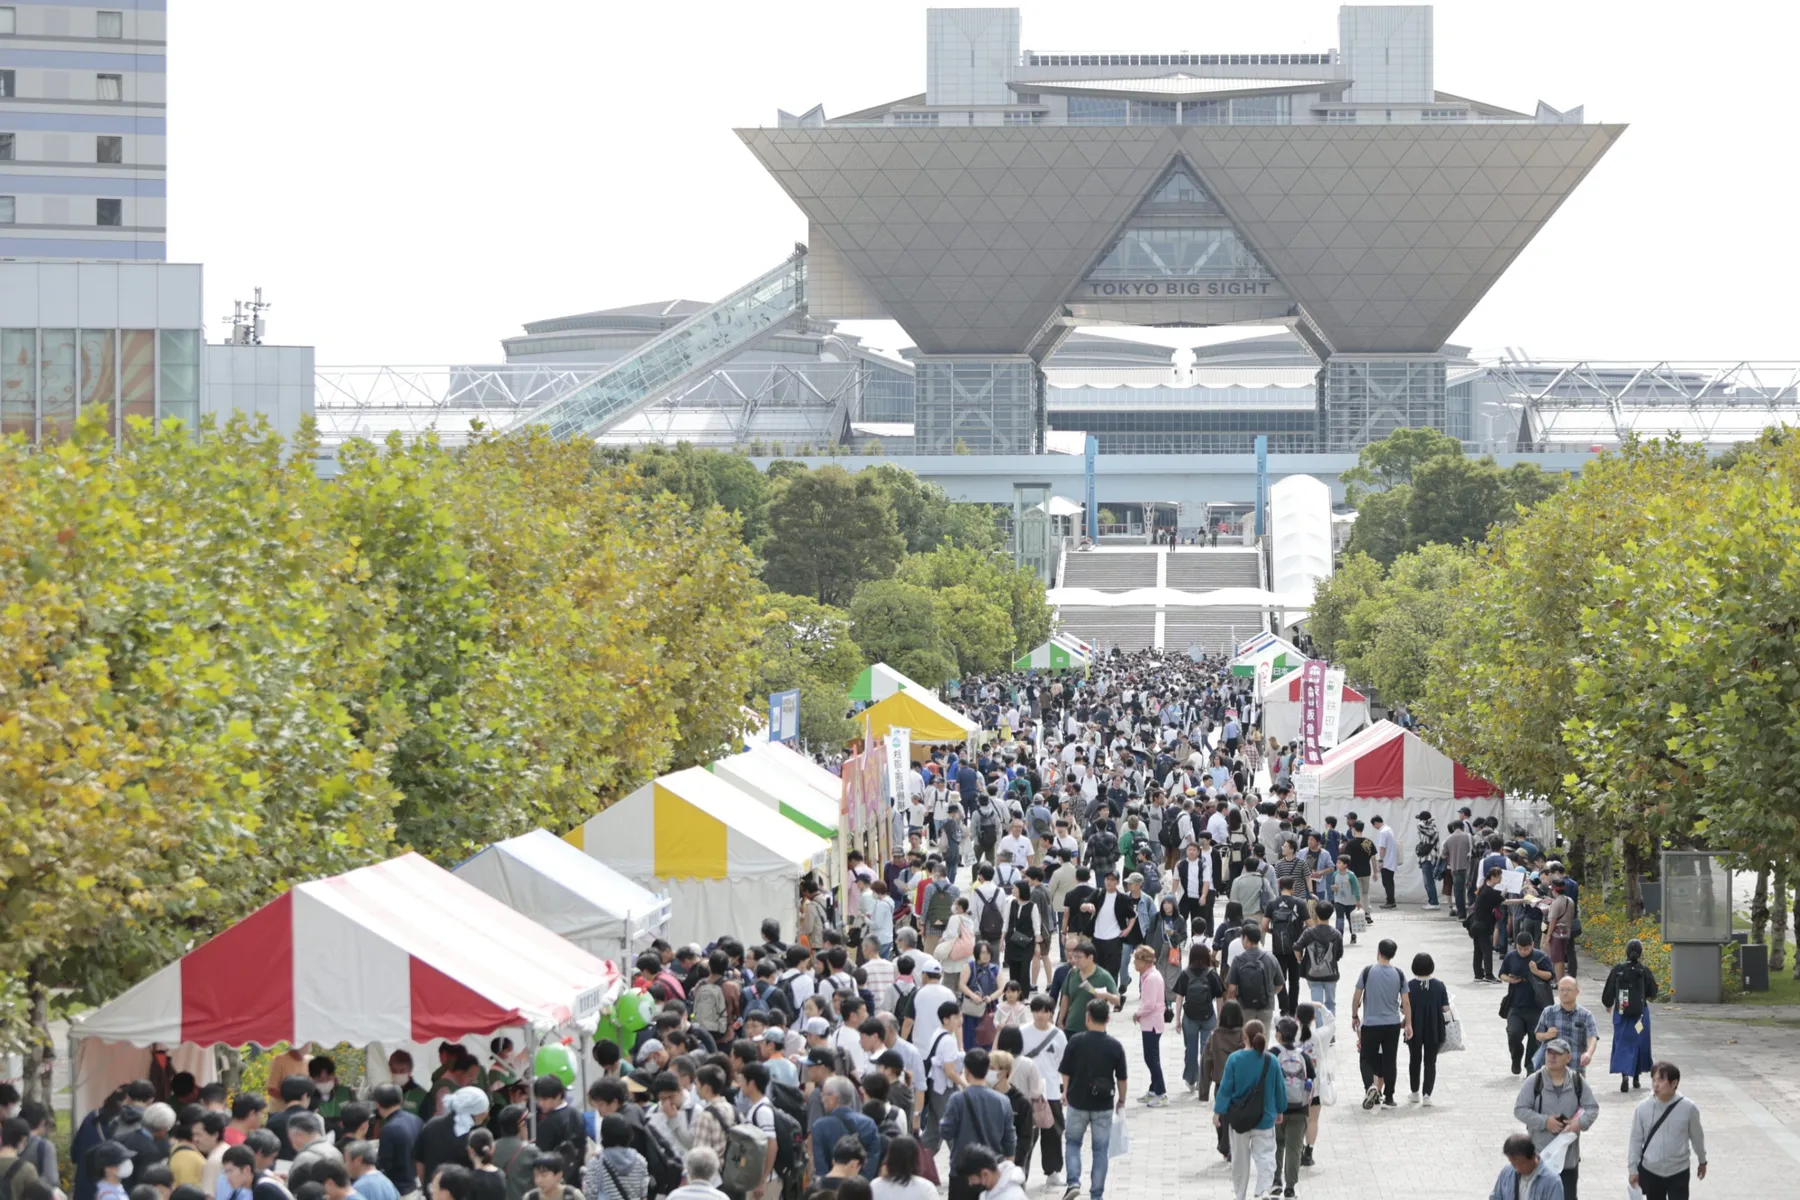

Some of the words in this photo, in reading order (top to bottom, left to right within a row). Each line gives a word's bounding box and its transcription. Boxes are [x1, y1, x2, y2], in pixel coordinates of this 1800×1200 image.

[1090, 283, 1158, 295] TOKYO
[1166, 283, 1200, 295] BIG
[1207, 282, 1271, 295] SIGHT
